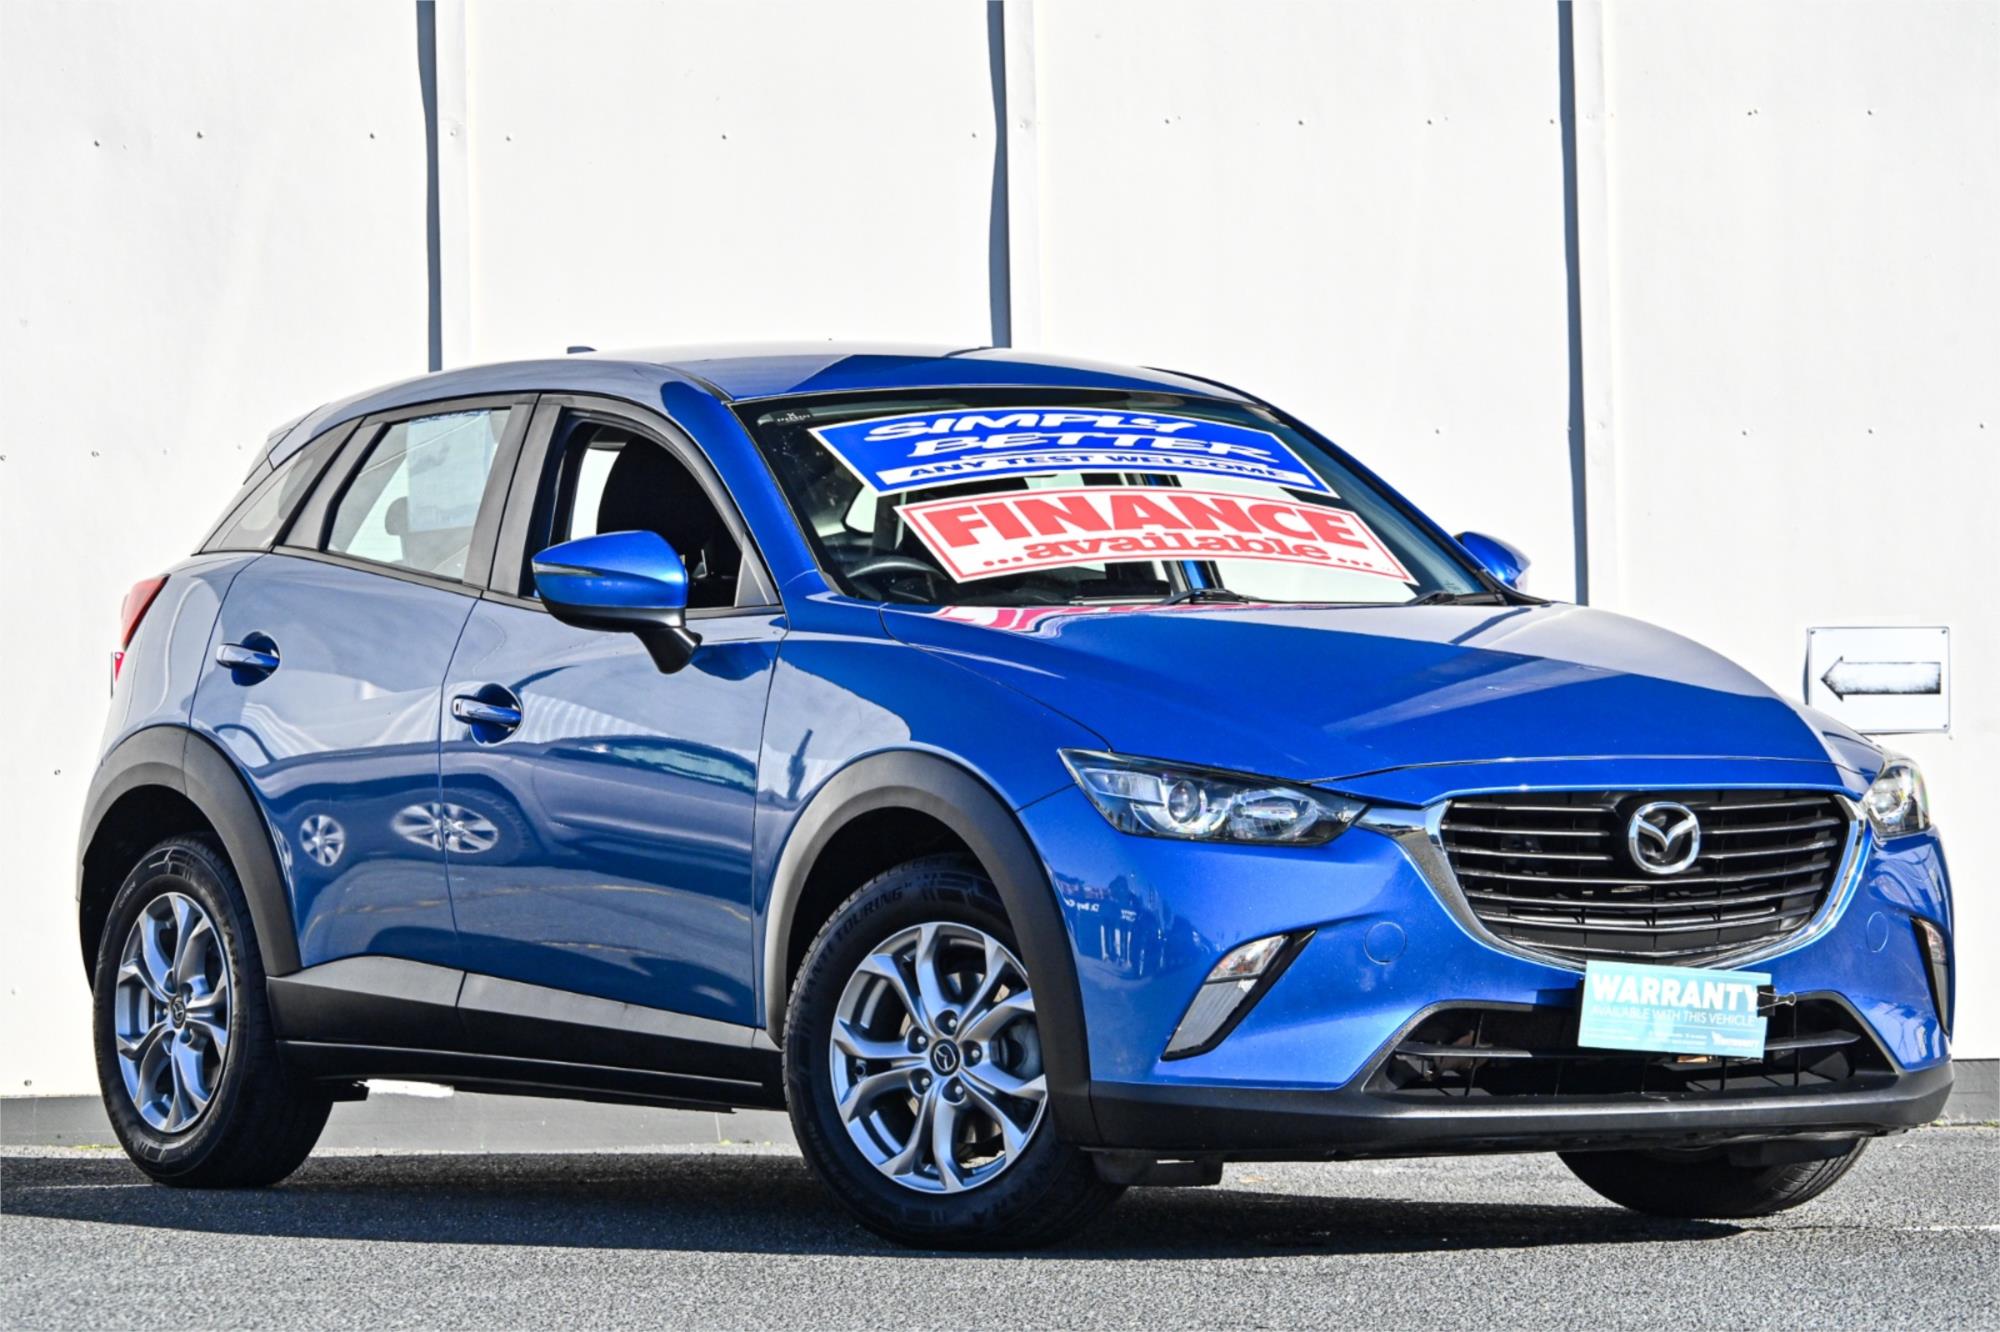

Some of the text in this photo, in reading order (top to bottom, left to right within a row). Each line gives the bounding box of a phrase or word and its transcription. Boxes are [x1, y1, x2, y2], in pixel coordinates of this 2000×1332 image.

[864, 413, 1198, 441] SIMPLY
[906, 432, 1280, 463] BETTER
[909, 455, 1287, 478] ANY TEST WELCOME
[922, 494, 1370, 548] FINANCE
[1591, 975, 1758, 1012] WARRANTY
[1652, 1008, 1681, 1022] WITH
[1684, 1010, 1706, 1024] THIS
